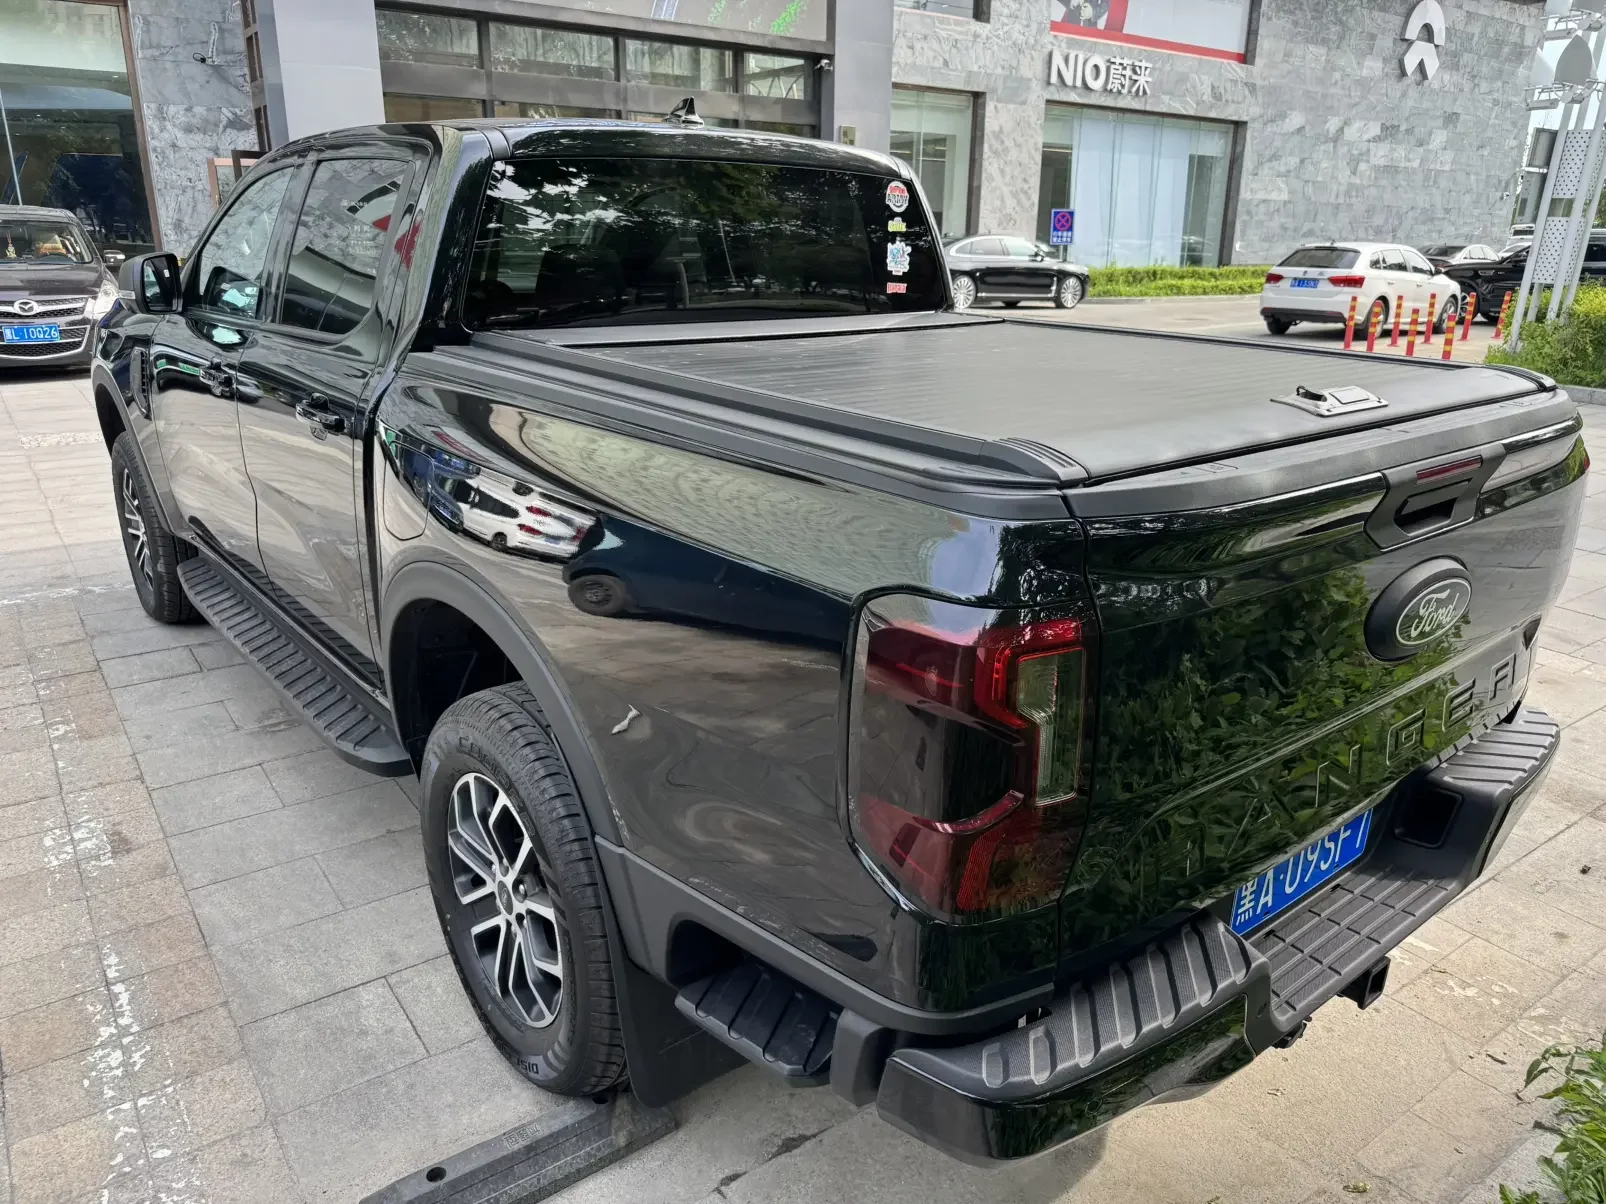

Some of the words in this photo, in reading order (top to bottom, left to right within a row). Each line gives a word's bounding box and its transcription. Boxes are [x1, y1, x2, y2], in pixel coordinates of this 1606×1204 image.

[1049, 48, 1107, 91] NIO
[1107, 55, 1153, 96] 蔚来
[1410, 588, 1460, 638] Ford
